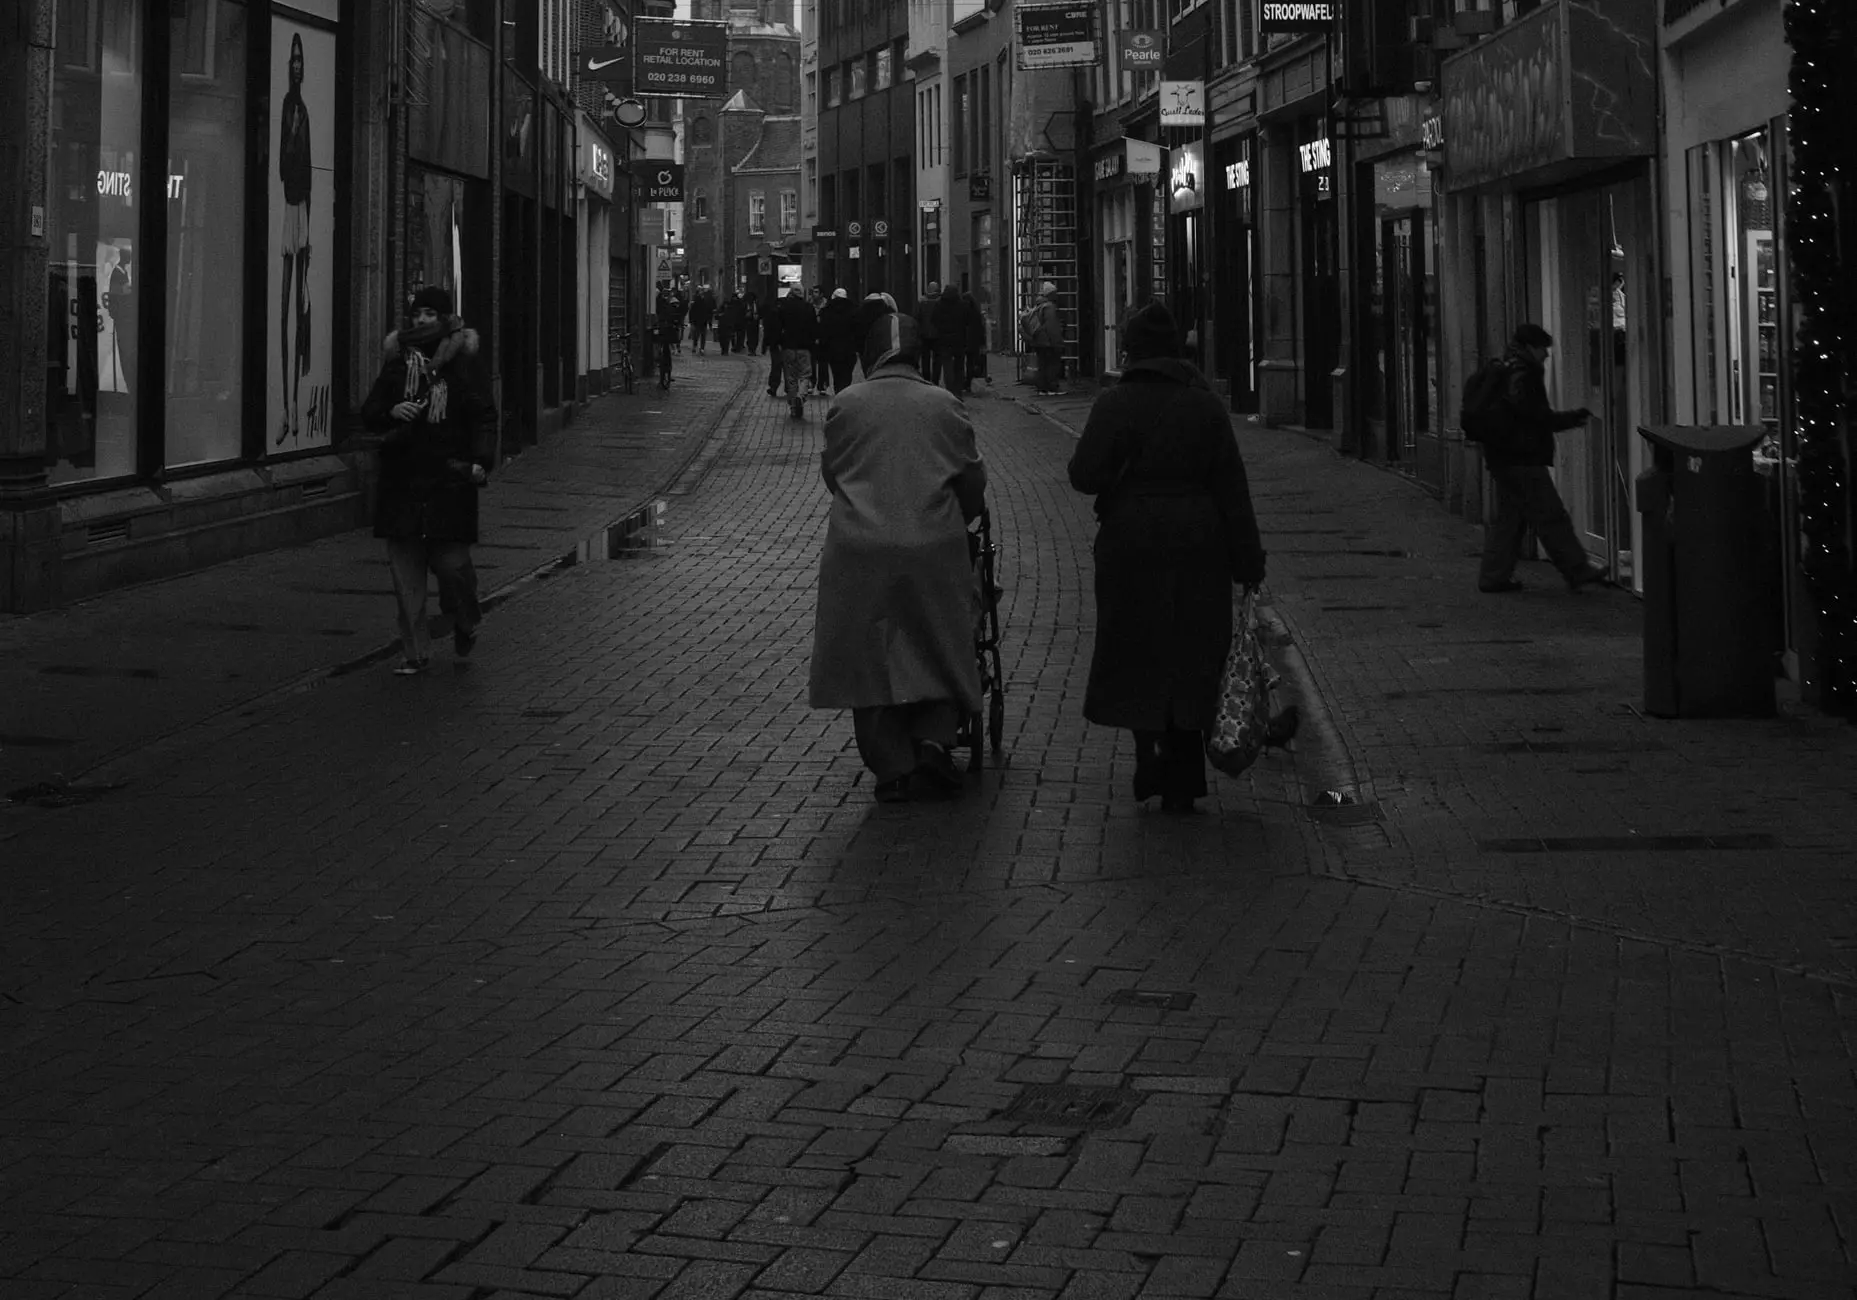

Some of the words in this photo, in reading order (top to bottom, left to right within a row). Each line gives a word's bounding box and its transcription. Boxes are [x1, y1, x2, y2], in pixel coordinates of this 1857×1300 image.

[660, 47, 679, 56] FOR
[680, 48, 704, 57] RENT
[1124, 49, 1160, 60] Pearle
[643, 55, 674, 65] RETAIL
[676, 57, 721, 67] LOCATION
[648, 72, 666, 81] 020
[667, 73, 686, 82] 238
[1300, 143, 1313, 173] THE
[1312, 137, 1331, 171] STING
[1225, 164, 1236, 190] THE
[1235, 160, 1249, 188] STING
